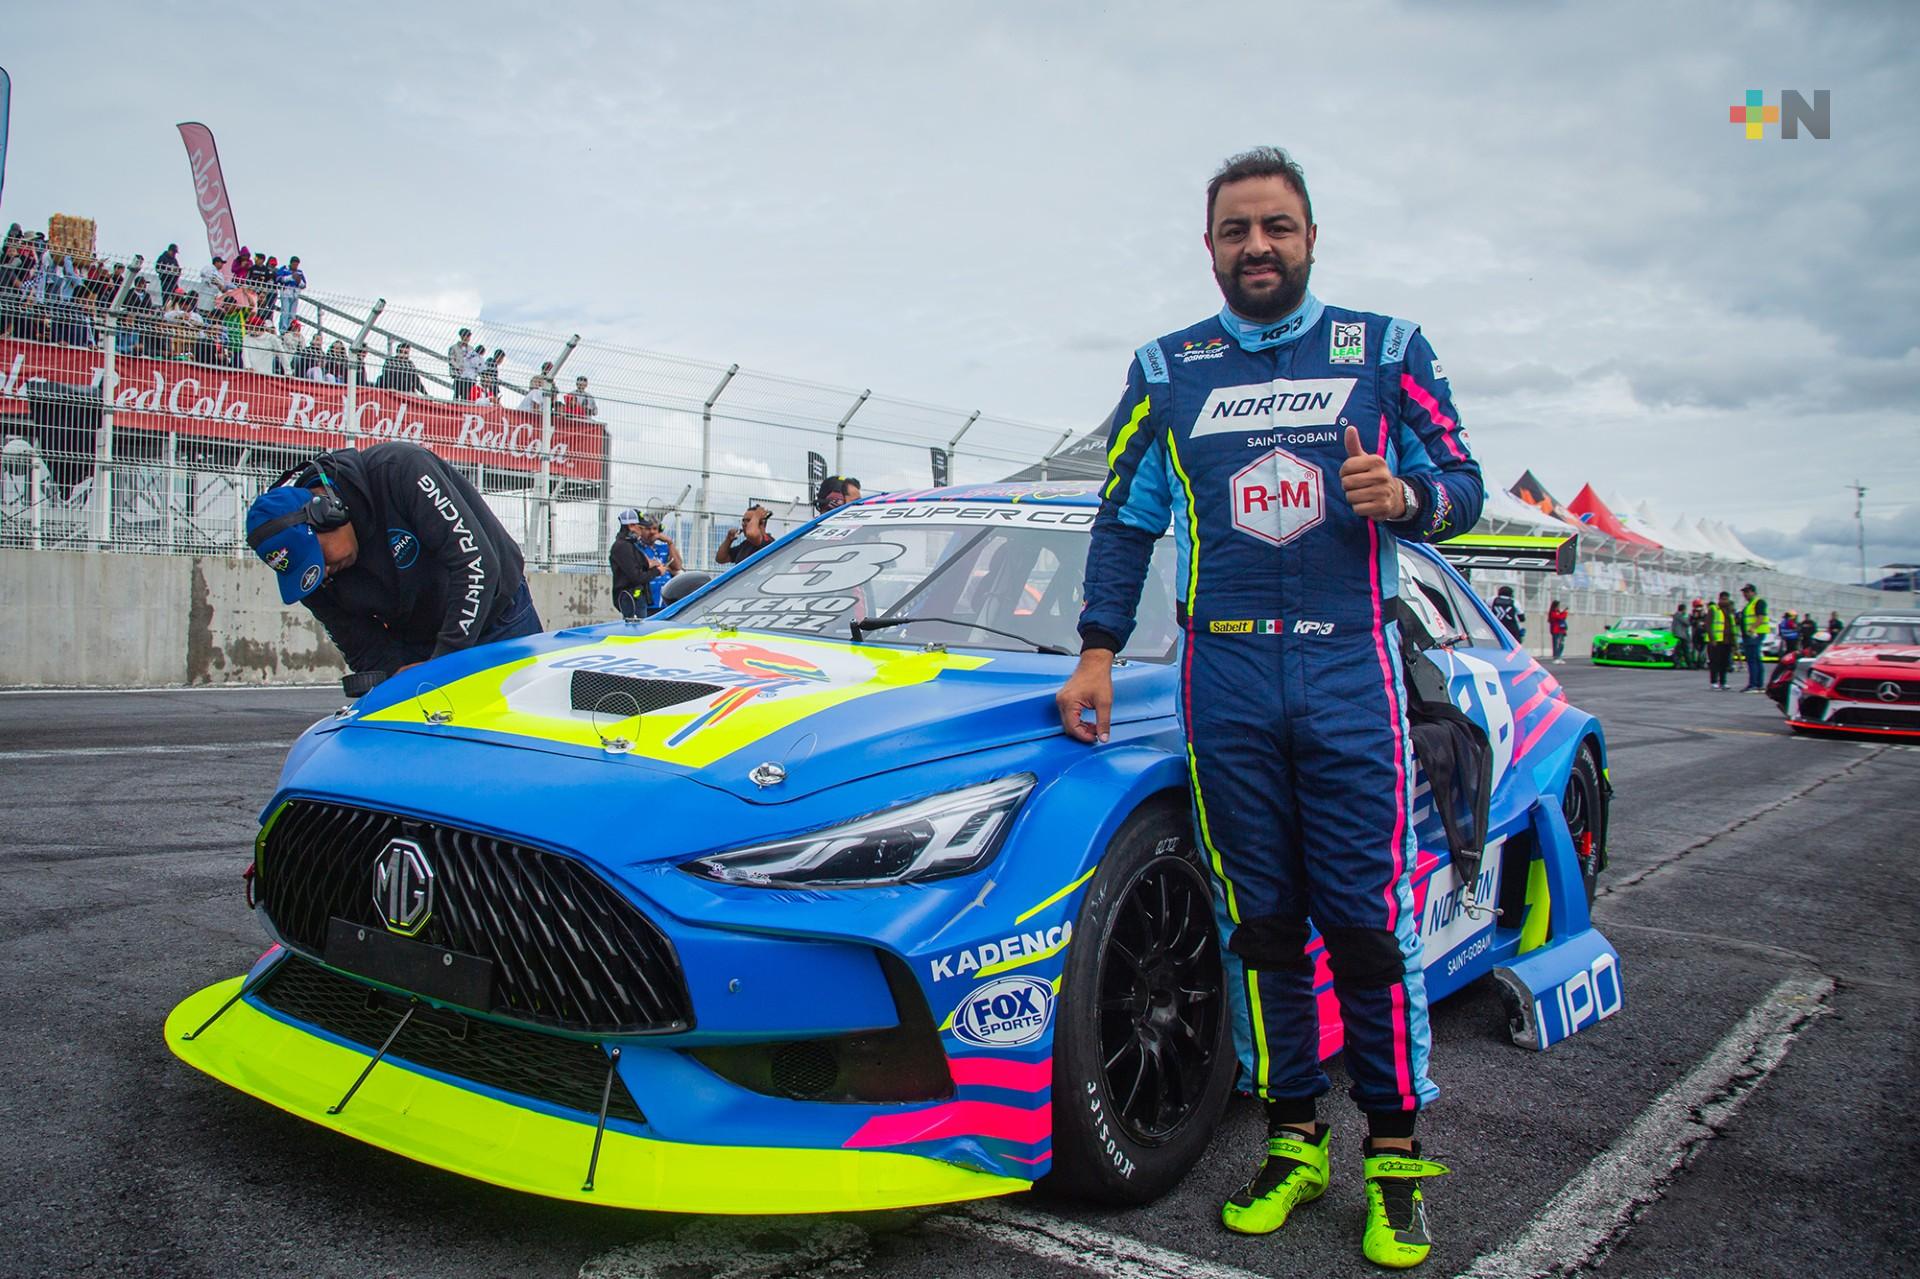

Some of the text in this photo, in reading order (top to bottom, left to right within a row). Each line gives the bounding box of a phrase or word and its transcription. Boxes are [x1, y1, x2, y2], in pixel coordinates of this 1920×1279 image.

[1332, 347, 1362, 357] LEAF
[1387, 325, 1406, 358] Sabelt
[1145, 346, 1164, 377] Sabelt
[168, 378, 250, 425] Cola
[1211, 391, 1333, 419] NORTON
[355, 401, 424, 444] Cola
[457, 413, 508, 453] Red
[1247, 431, 1338, 447] SAINT-GOBAIN
[1243, 480, 1311, 514] R-M
[416, 474, 485, 636] ALPHA RACING
[758, 542, 907, 596] 3
[707, 597, 859, 613] KEKO
[1213, 621, 1249, 632] Sabelt
[376, 848, 426, 926] MG
[1447, 934, 1492, 977] SAINT-GOBAIN
[972, 987, 1040, 1027] FOX
[979, 1013, 1043, 1037] SPORTS
